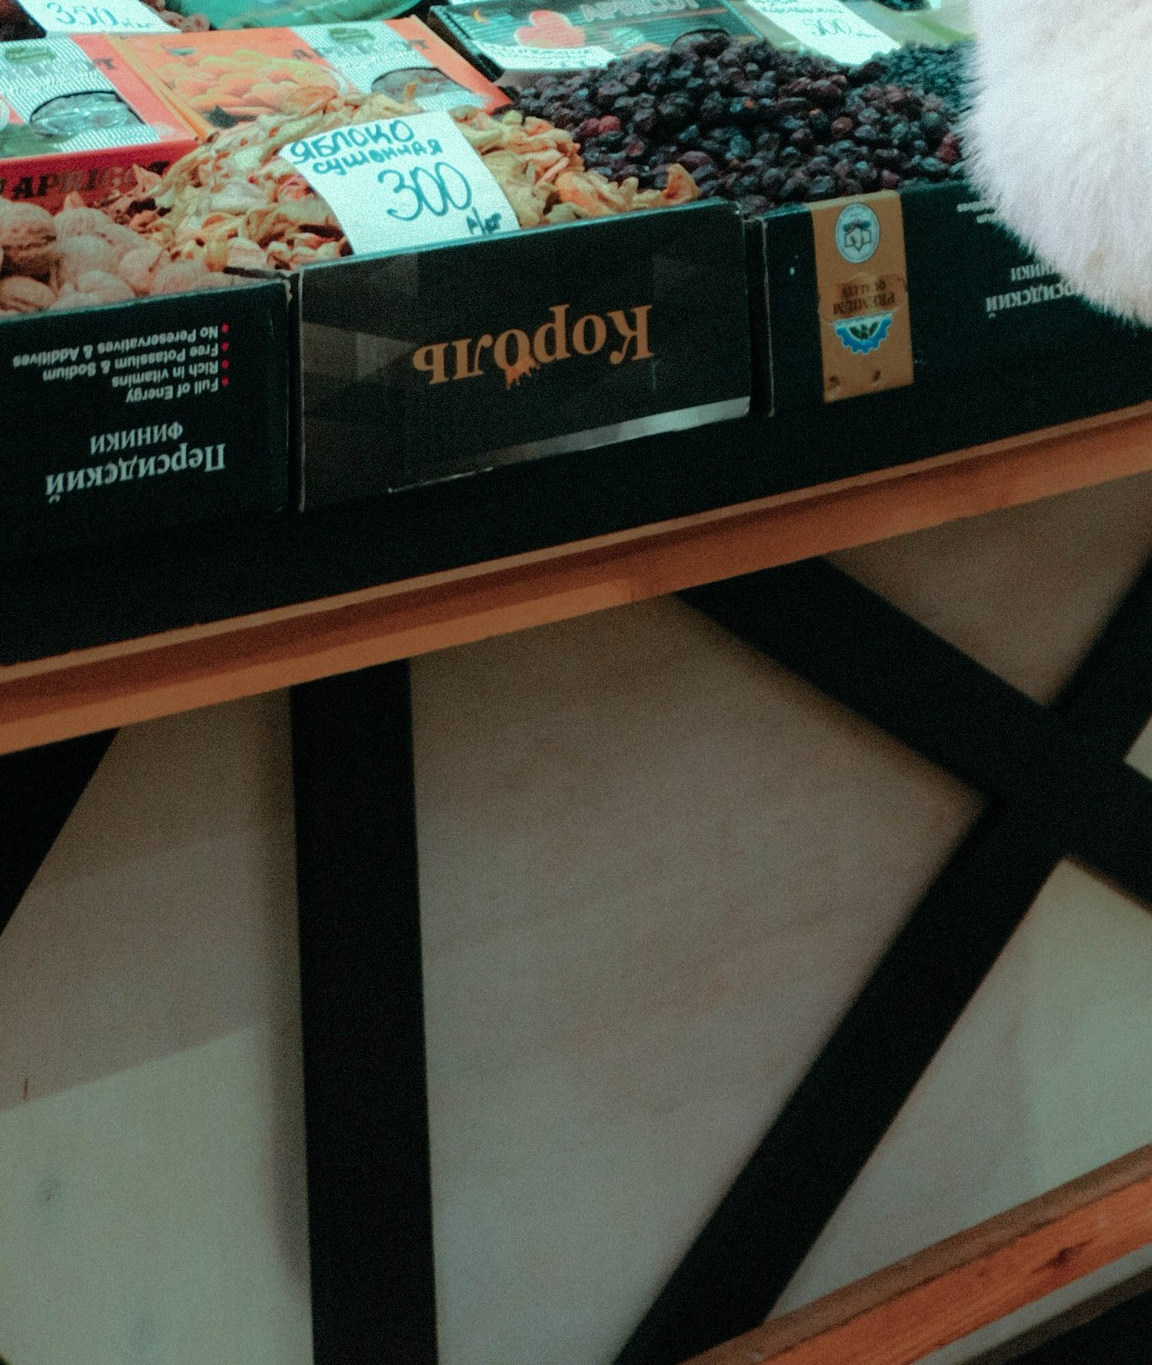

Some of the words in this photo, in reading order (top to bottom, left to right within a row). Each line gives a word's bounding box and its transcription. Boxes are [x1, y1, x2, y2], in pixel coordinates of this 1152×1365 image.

[47, 2, 118, 26] 350
[377, 161, 472, 221] 300
[199, 325, 219, 339] No
[189, 342, 219, 357] Free
[412, 303, 655, 386] Король
[12, 346, 79, 368] Additives
[114, 348, 186, 369] Potassium
[42, 362, 97, 381] Sodium
[172, 365, 185, 378] in
[189, 360, 219, 375] Rich
[111, 370, 169, 388] vitamins
[195, 377, 219, 394] Full
[125, 385, 173, 403] Energy
[177, 384, 190, 398] of
[45, 442, 226, 503] Персидский
